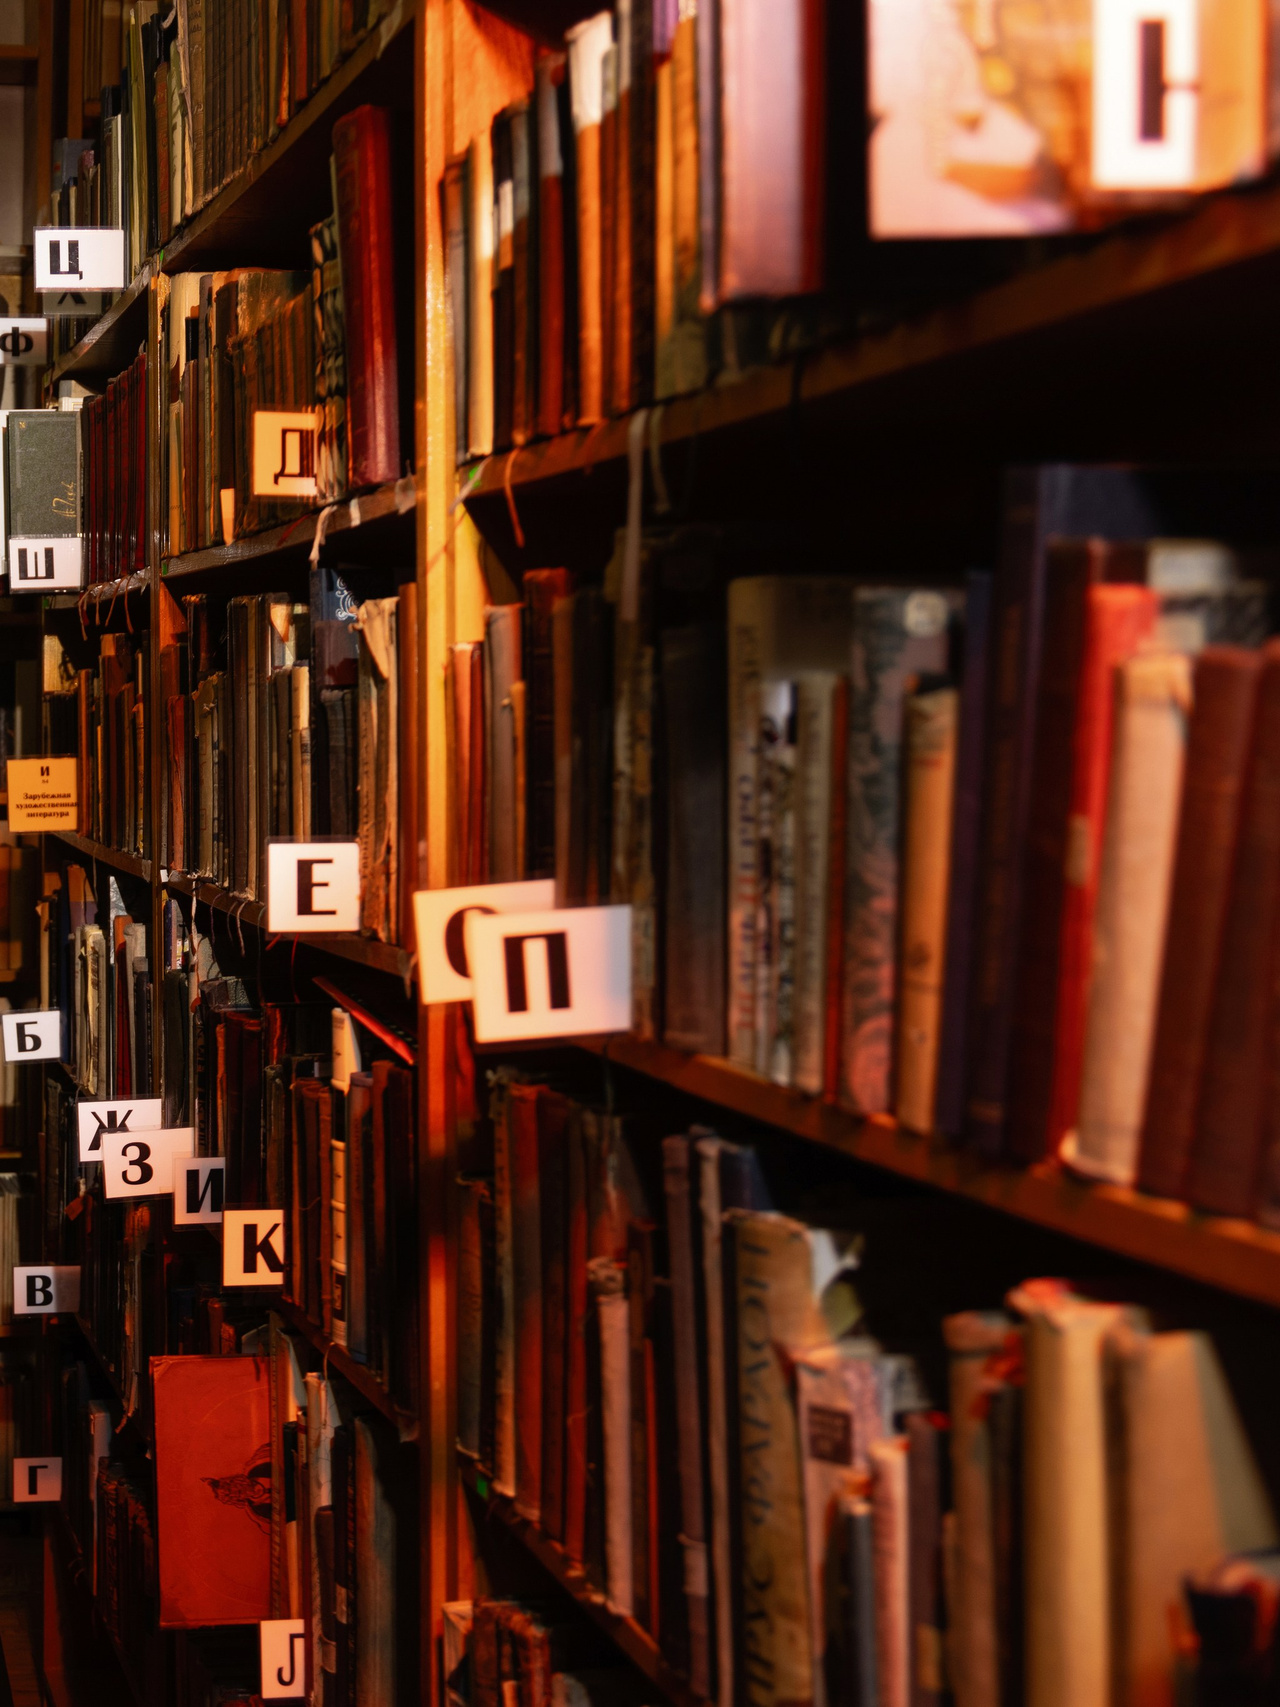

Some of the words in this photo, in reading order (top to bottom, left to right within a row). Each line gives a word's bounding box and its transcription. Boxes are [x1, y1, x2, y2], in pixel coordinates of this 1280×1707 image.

[49, 240, 83, 280] Ц
[274, 428, 318, 487] Д
[17, 547, 55, 580] Ш
[40, 765, 50, 777] И
[23, 792, 71, 800] Зарубежная
[296, 858, 338, 916] Е
[503, 931, 572, 1013] П
[16, 1021, 42, 1053] Б
[186, 1168, 225, 1214] И
[243, 1222, 284, 1274] К
[26, 1274, 54, 1307] В
[27, 1464, 49, 1496] Г
